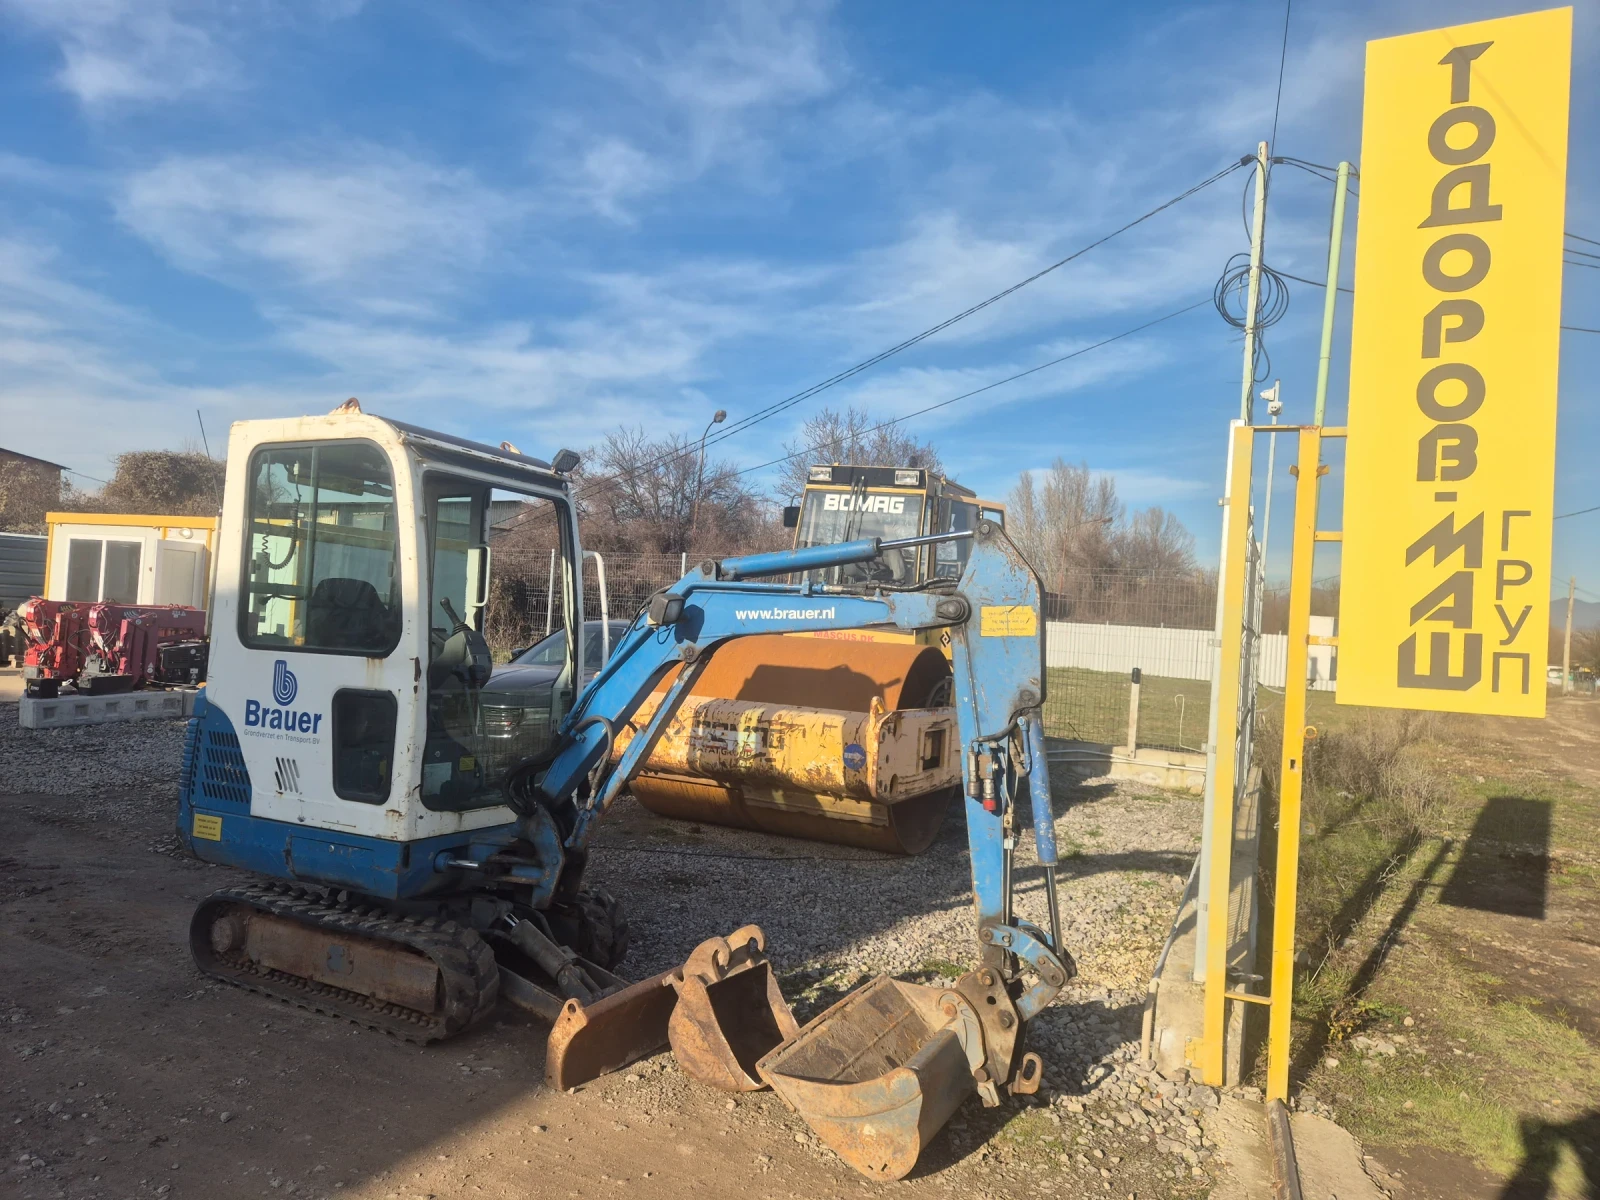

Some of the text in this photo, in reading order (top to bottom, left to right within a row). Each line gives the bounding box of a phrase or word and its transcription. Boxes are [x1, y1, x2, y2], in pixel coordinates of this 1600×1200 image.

[823, 493, 905, 514] BOMAG
[1491, 510, 1532, 694] ГРУП
[735, 606, 835, 620] www.brauer.nl
[813, 630, 875, 643] MASCUS.DK
[244, 699, 323, 734] Brauer
[244, 729, 275, 740] Grondverzet
[285, 733, 311, 743] Transport
